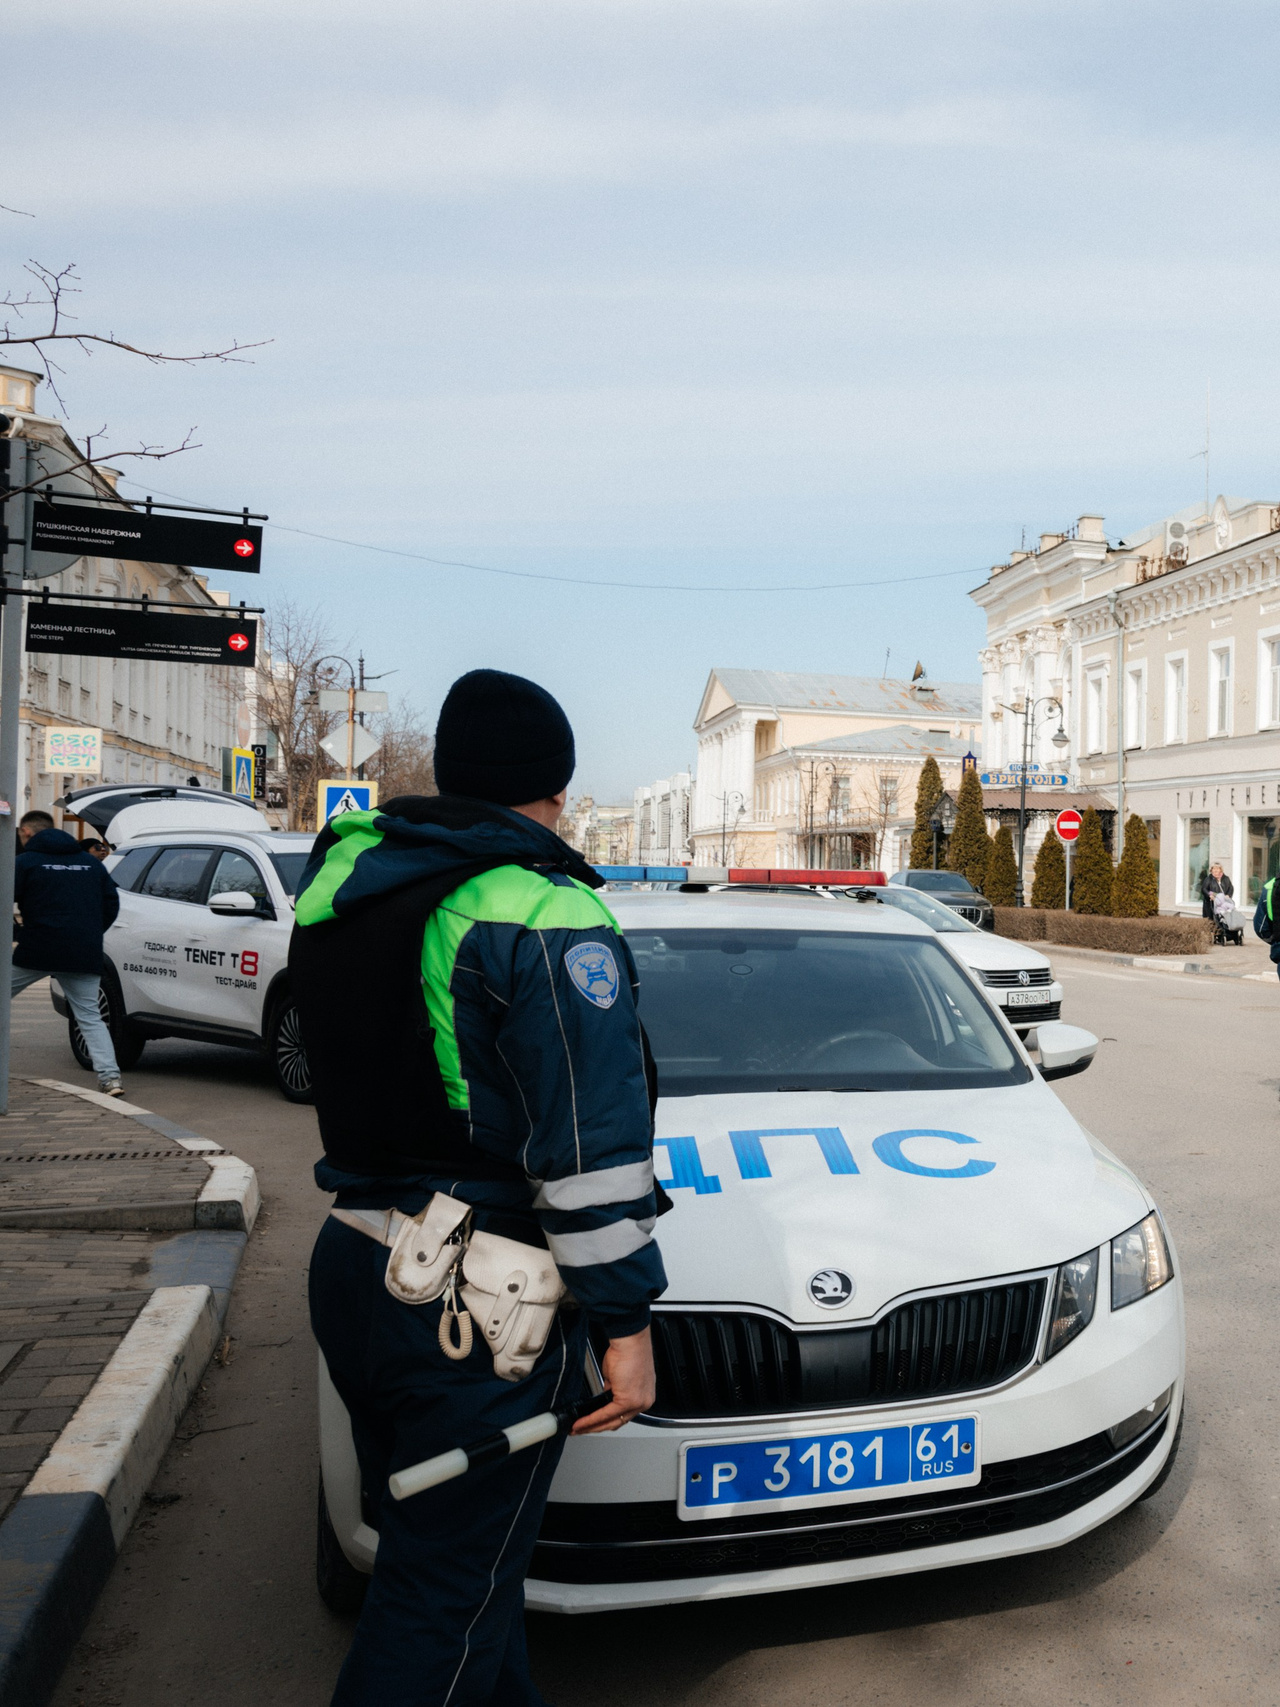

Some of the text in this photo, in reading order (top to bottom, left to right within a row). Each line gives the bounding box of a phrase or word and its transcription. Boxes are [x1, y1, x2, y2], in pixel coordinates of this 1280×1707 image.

[36, 521, 141, 539] ПУШКИНСКАЯ НАБЕРЕЖНАЯ
[36, 532, 115, 545] PUSHKINSKAYA EMBANKMENT
[30, 623, 116, 636] КАМЕННАЯ ЛЕСТНИЦА
[254, 746, 264, 797] ОТЕЛЬ
[1011, 764, 1038, 772] HOEL
[144, 941, 177, 953] ГЕДОН-ЮГ
[184, 947, 226, 967] TENET
[123, 962, 178, 978] 8 863 460 99 70
[214, 975, 257, 990] ТЕСТ-ДРАЙВ
[653, 1126, 997, 1196] ДПС
[764, 1436, 883, 1492] 3181
[916, 1424, 959, 1462] 61
[922, 1459, 954, 1476] RUS
